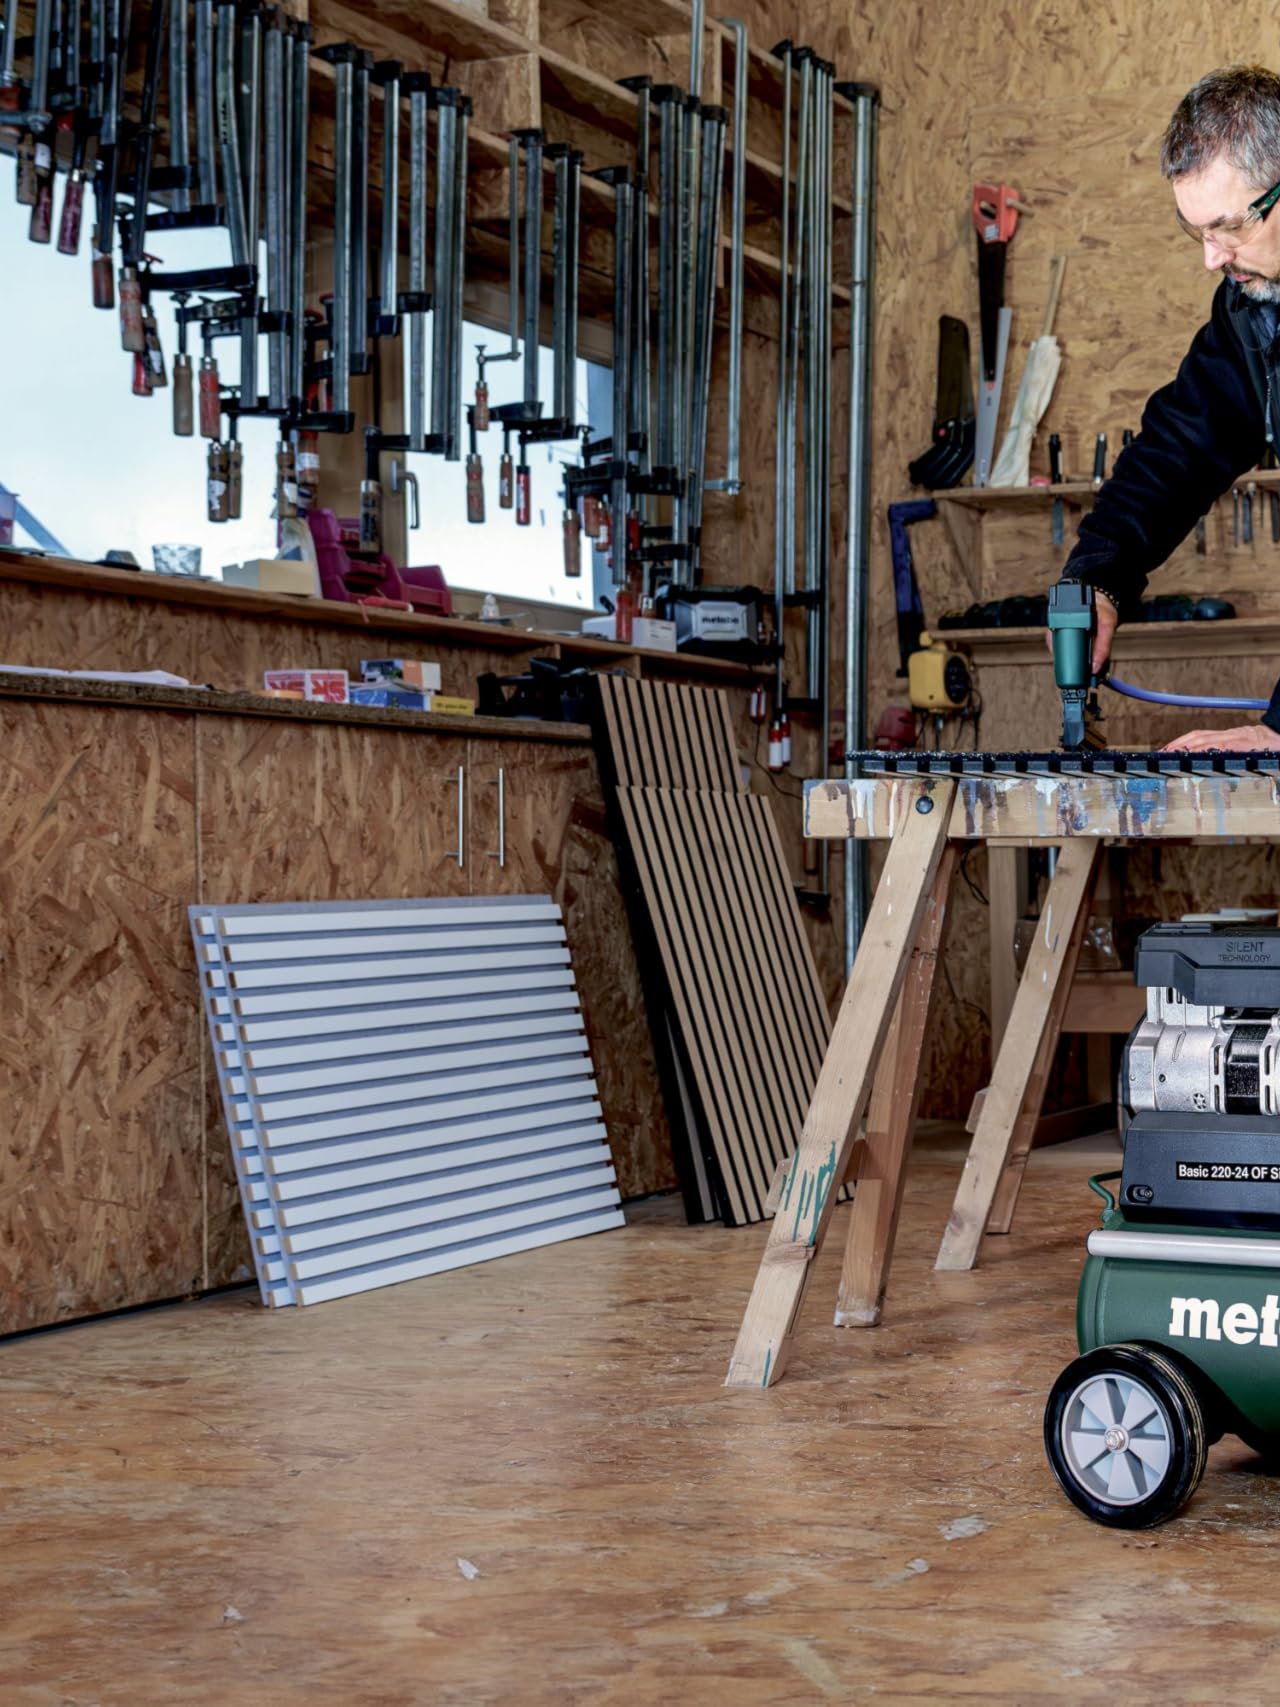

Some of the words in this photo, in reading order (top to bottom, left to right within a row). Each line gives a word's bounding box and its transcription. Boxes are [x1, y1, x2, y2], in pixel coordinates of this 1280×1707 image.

[1226, 941, 1265, 952] SILENT
[1219, 954, 1271, 962] TECHNOLOGY
[1178, 1164, 1209, 1177] Basic
[1211, 1166, 1249, 1178] 220-24
[1251, 1166, 1268, 1179] OF
